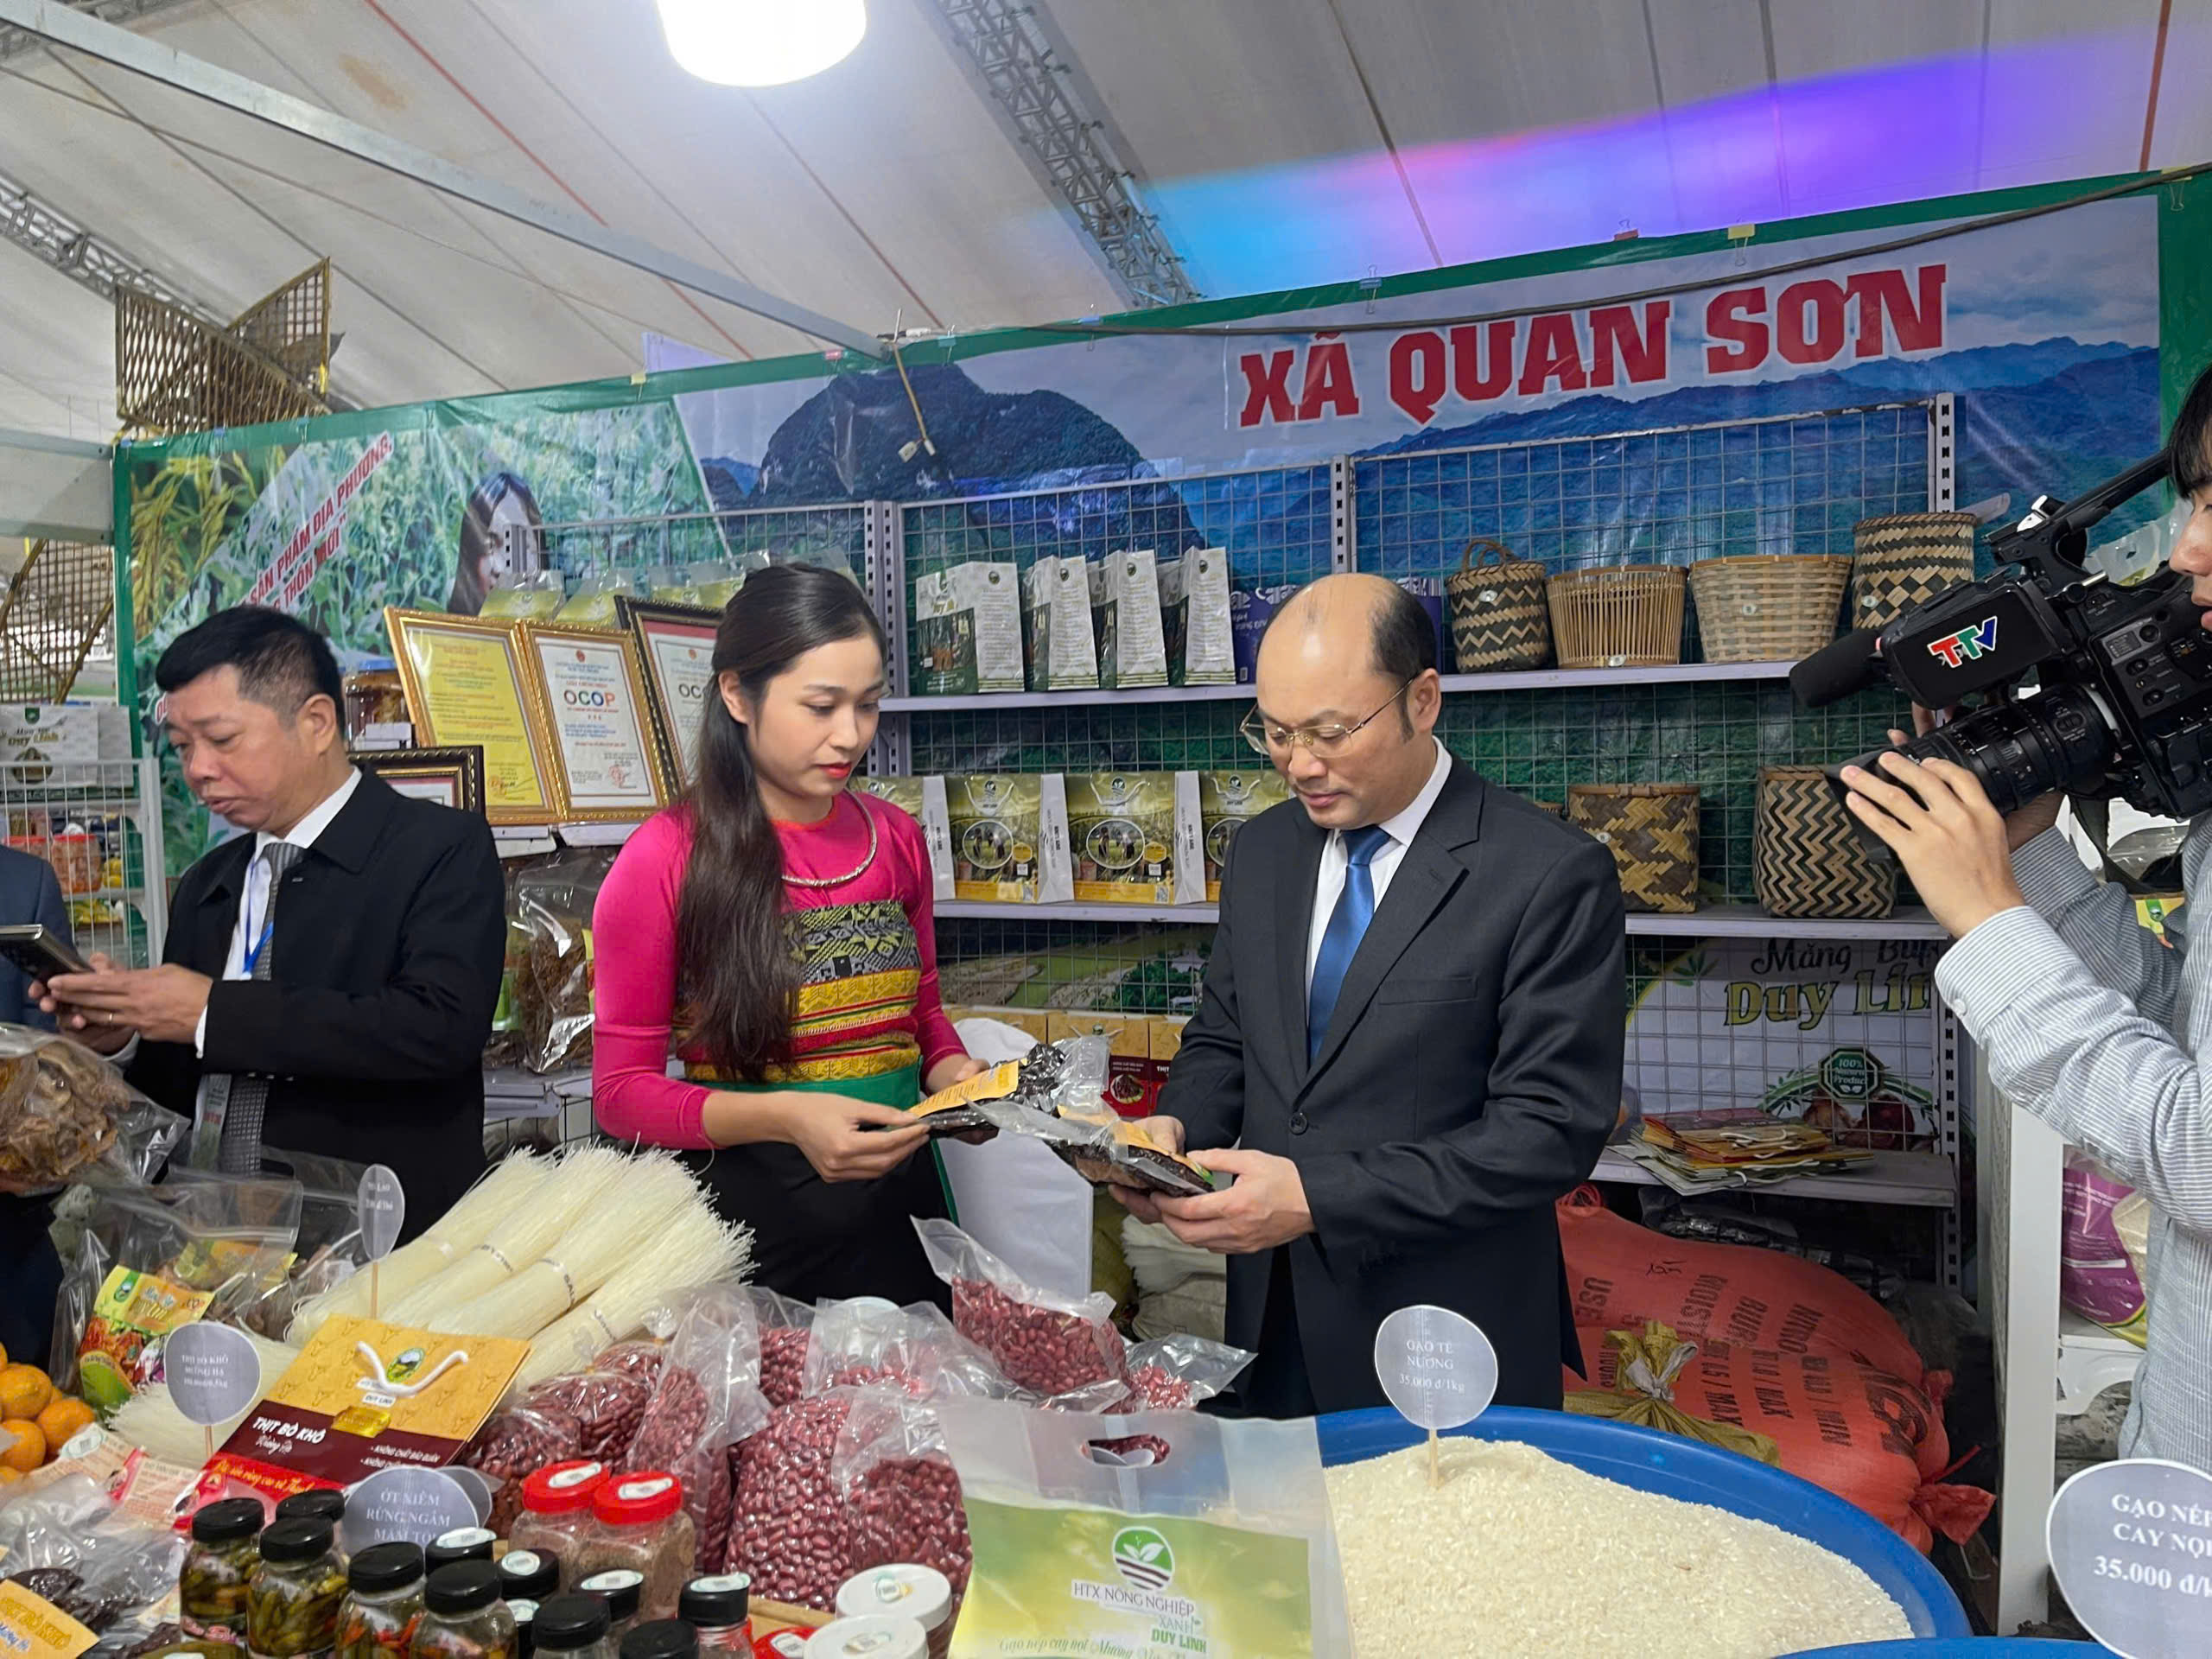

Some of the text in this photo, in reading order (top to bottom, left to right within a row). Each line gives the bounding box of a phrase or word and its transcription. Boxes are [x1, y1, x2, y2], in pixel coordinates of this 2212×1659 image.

[1239, 264, 1946, 428] XÃ QUAN SƠN
[1928, 616, 1998, 668] TTV
[563, 690, 616, 707] OCOP
[1751, 938, 1852, 974] Măng
[1724, 981, 1839, 1030] Duy
[1575, 1277, 1613, 1320] USE
[1705, 1391, 1744, 1427] MAX
[1755, 1387, 1794, 1419] MAX
[2111, 1494, 2165, 1518] GẠO
[2113, 1523, 2164, 1547] CAY
[2094, 1555, 2172, 1590] 35.000
[1074, 1582, 1195, 1618] HTX NÔNG NGHIỆP
[1152, 1628, 1177, 1644] DUY
[1179, 1633, 1207, 1653] LINH
[1159, 1616, 1193, 1634] XANH
